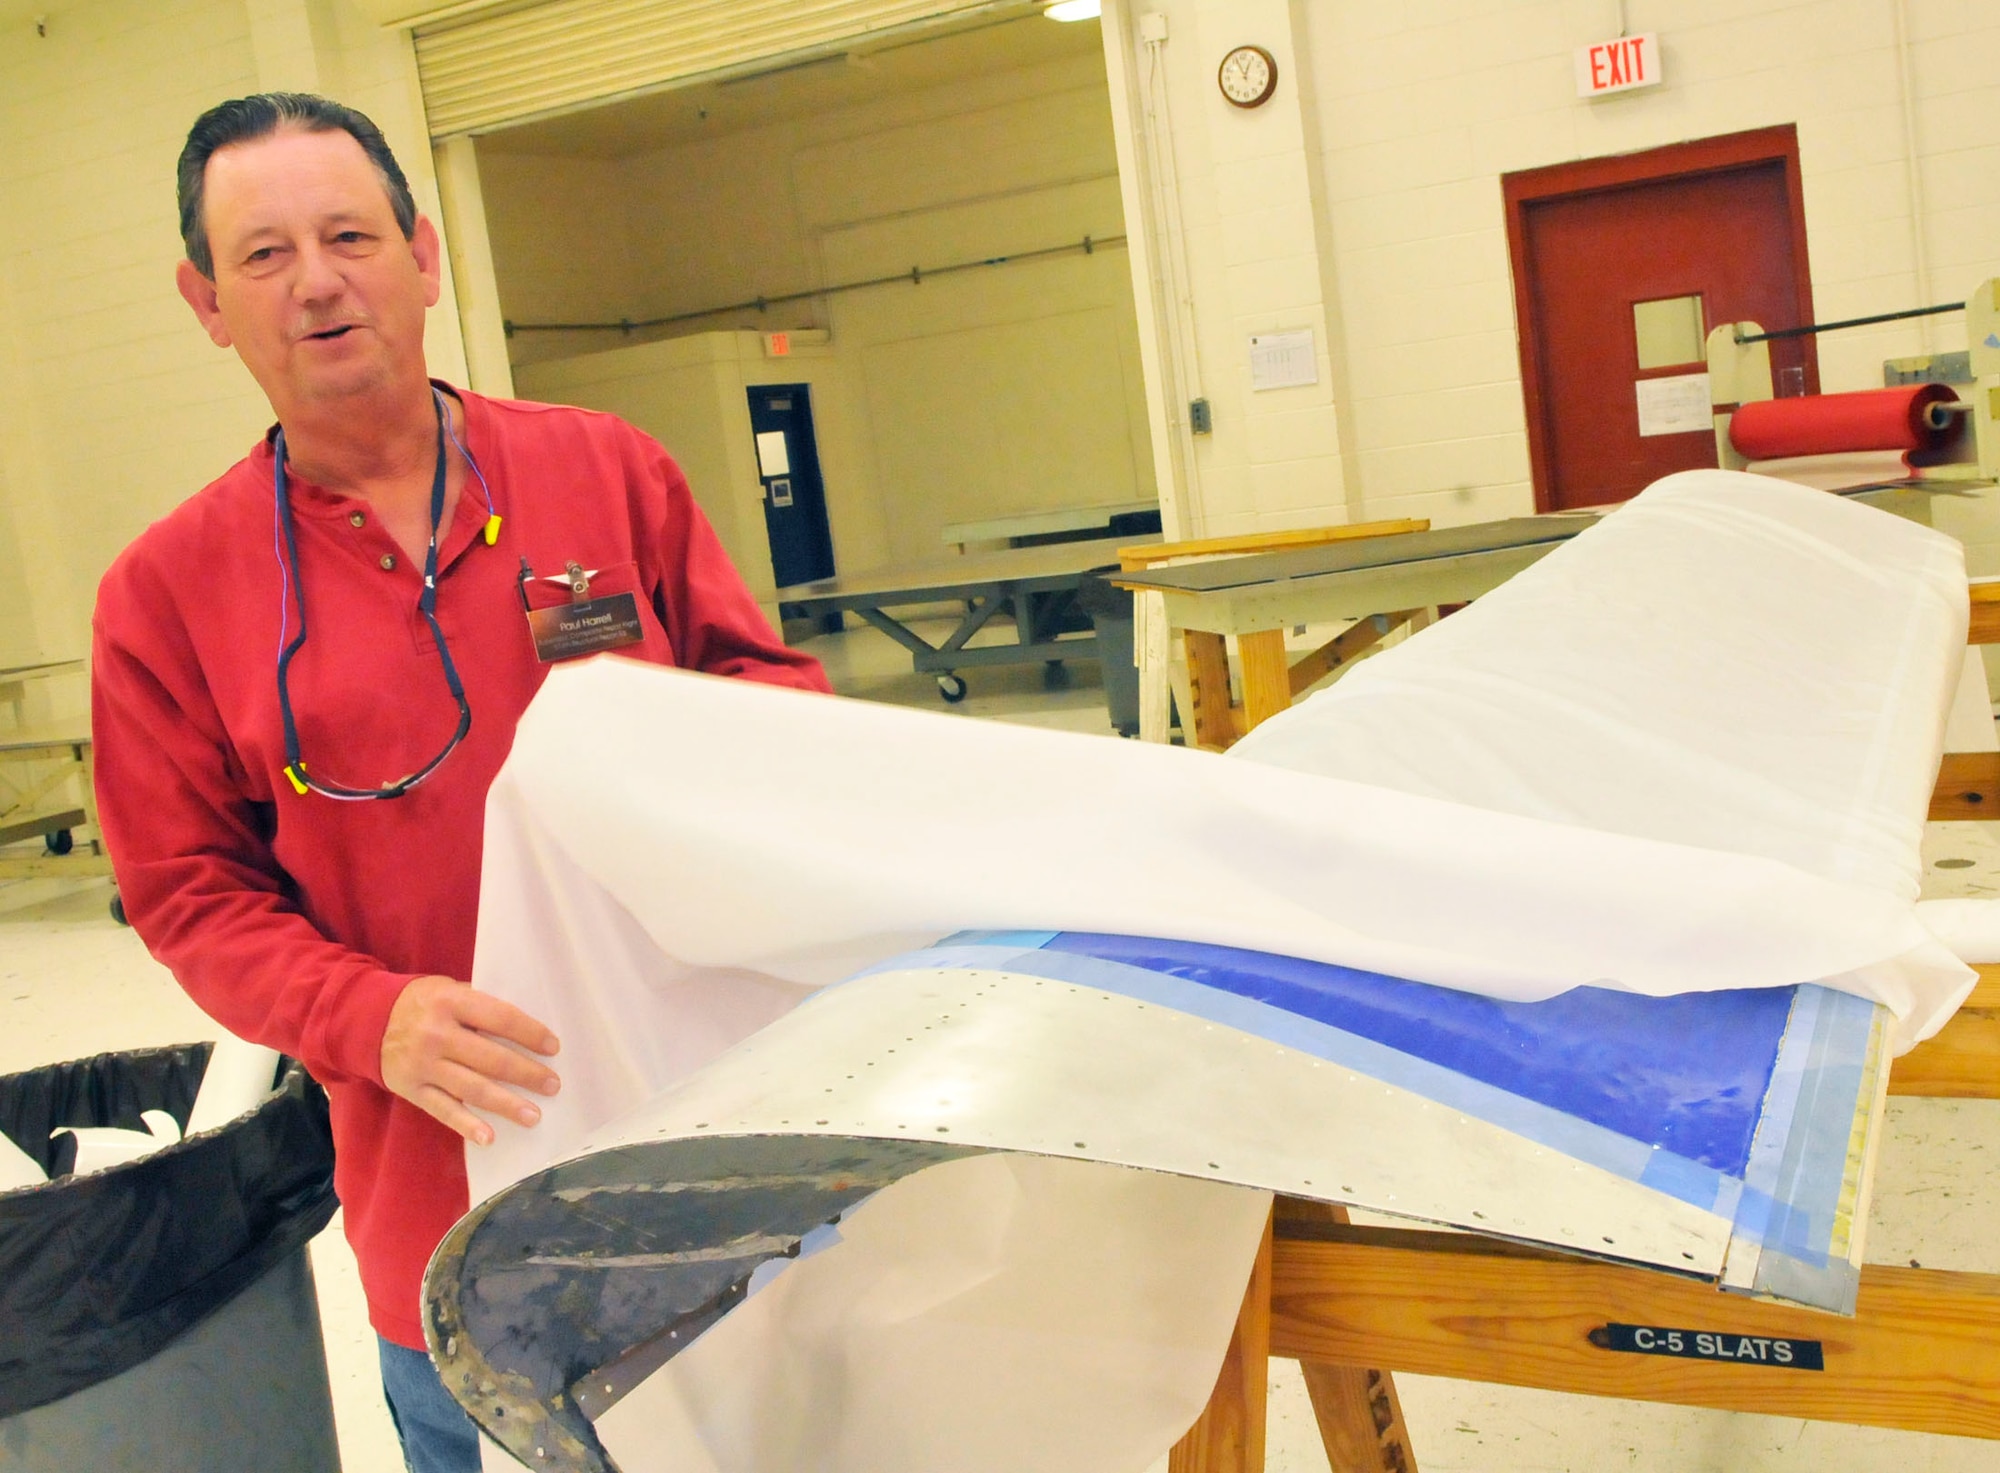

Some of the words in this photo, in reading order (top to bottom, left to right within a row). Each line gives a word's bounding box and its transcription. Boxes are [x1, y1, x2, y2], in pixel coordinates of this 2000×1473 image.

[1589, 37, 1645, 90] EXIT
[559, 618, 582, 632] Paul
[581, 612, 612, 627] Harrell
[1634, 1328, 1684, 1352] C-5
[1695, 1333, 1794, 1362] SLATS
